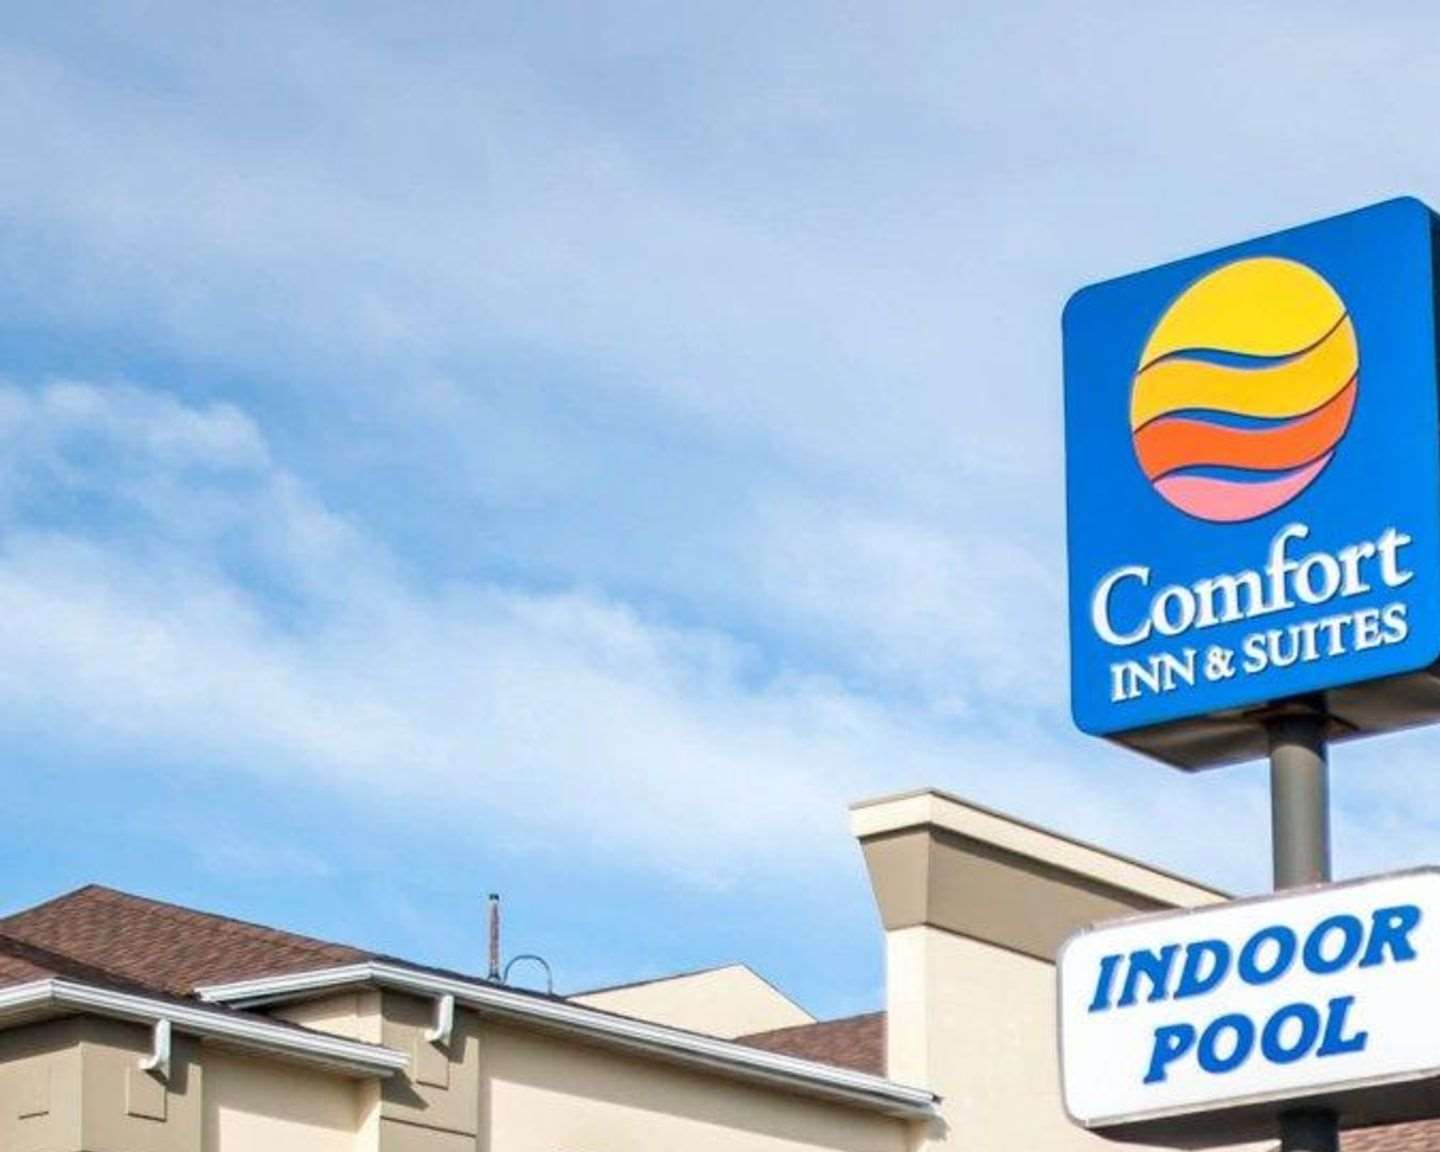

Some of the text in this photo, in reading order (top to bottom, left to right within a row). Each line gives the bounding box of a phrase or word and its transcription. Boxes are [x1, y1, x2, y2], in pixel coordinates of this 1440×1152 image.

[1092, 523, 1413, 646] Comfort
[1110, 603, 1408, 702] INN & SUITES
[1088, 904, 1422, 1013] INDOOR
[1143, 995, 1369, 1085] POOL
